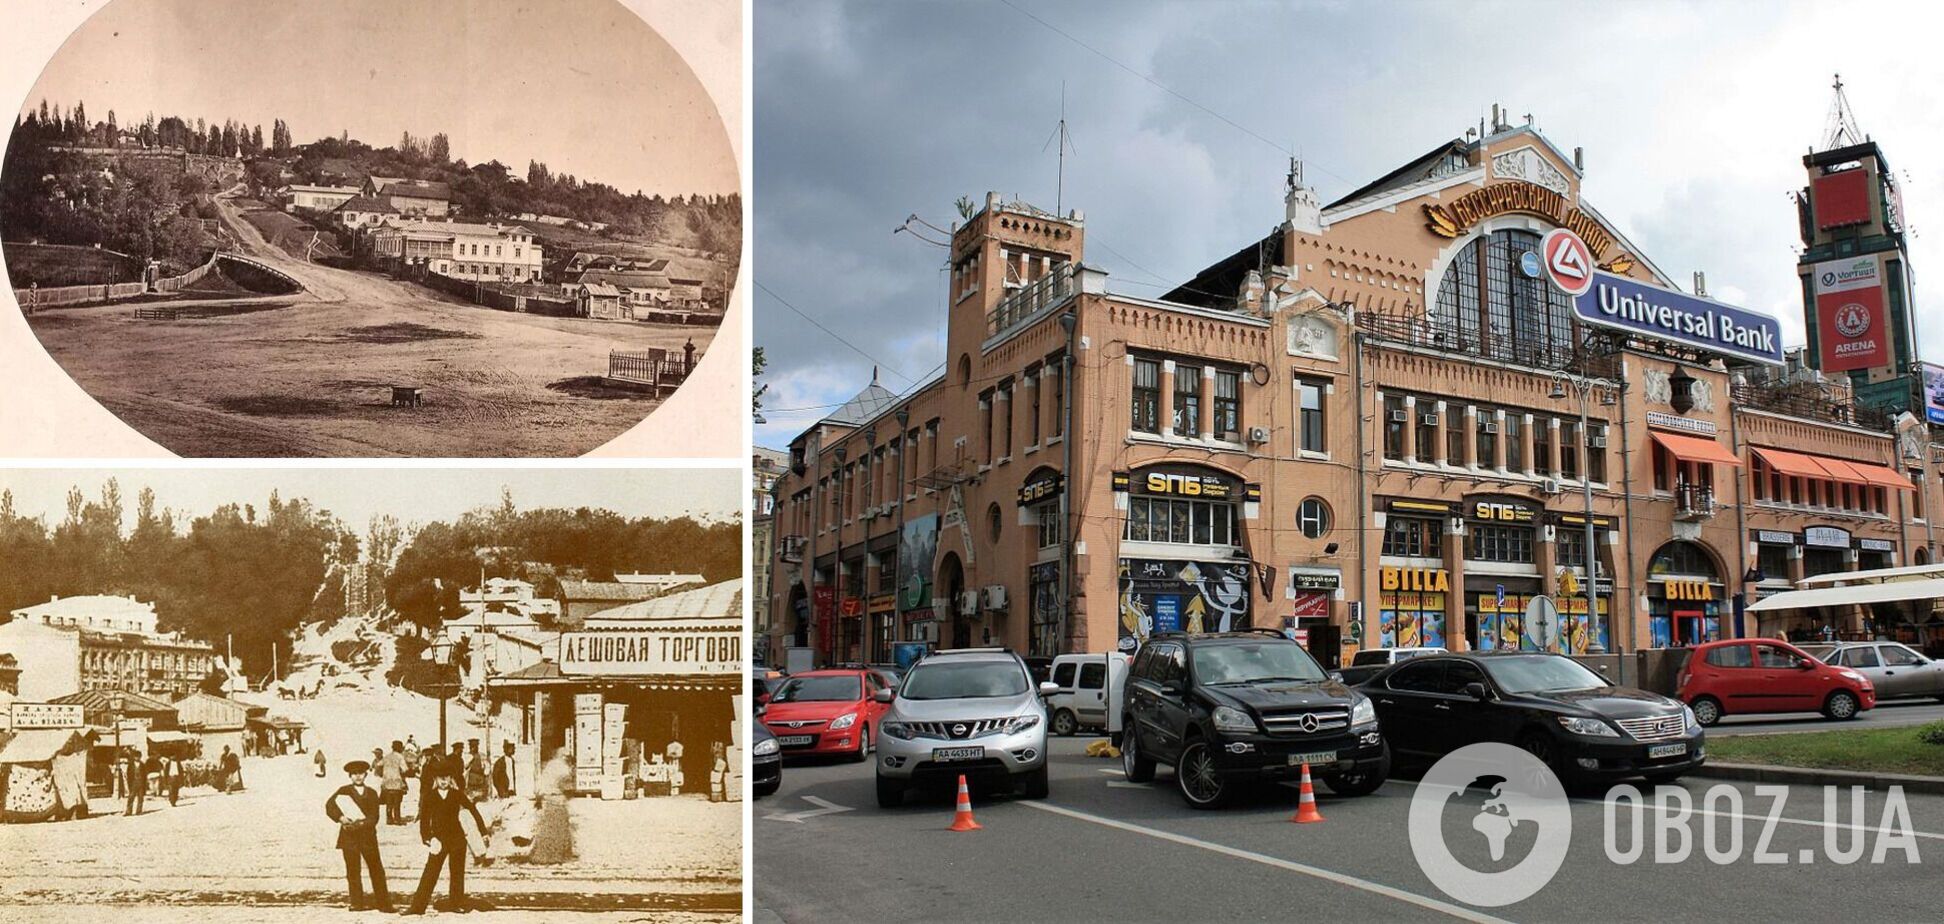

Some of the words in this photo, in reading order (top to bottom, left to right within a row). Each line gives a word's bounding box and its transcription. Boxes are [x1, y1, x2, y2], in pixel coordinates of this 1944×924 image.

[1453, 181, 1564, 228] БЕССАРАБСЬКИЙ
[1598, 283, 1715, 339] Universal
[1719, 314, 1776, 353] Bank
[1835, 340, 1876, 353] ARENA
[1382, 566, 1449, 592] BILLA
[1666, 578, 1712, 600] BILLA
[566, 637, 649, 663] ДЕШОВАЯ
[659, 636, 742, 662] ТОРГОВЛ
